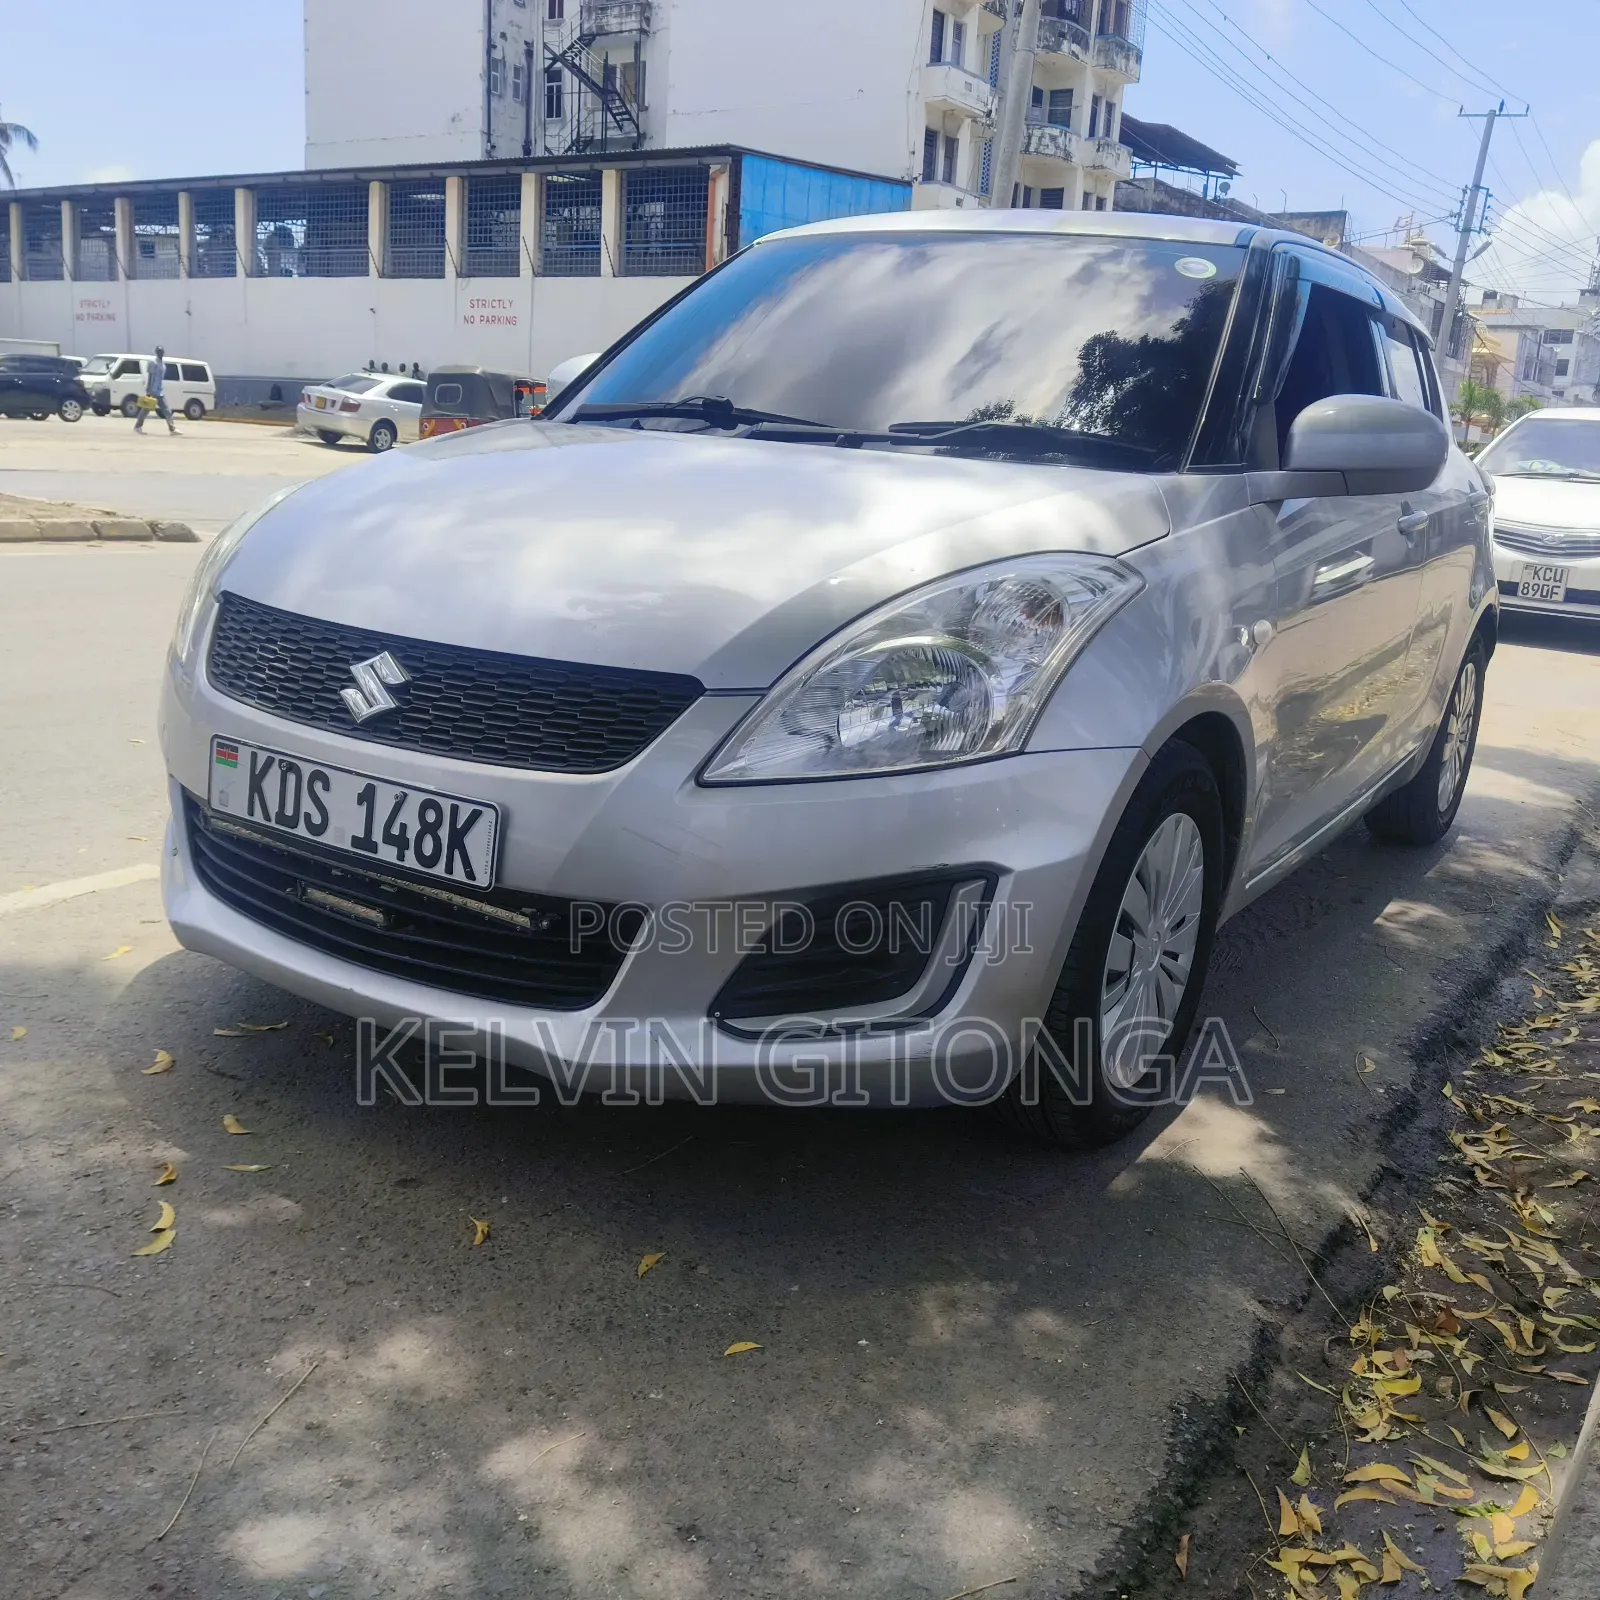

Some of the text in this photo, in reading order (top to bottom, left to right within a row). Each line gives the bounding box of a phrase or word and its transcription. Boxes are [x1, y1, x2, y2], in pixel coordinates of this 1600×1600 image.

[469, 299, 513, 309] STRICTLY
[463, 314, 517, 326] NO PARKING
[1532, 565, 1564, 584] KCU
[247, 750, 331, 837] KDS
[350, 782, 484, 881] 148K
